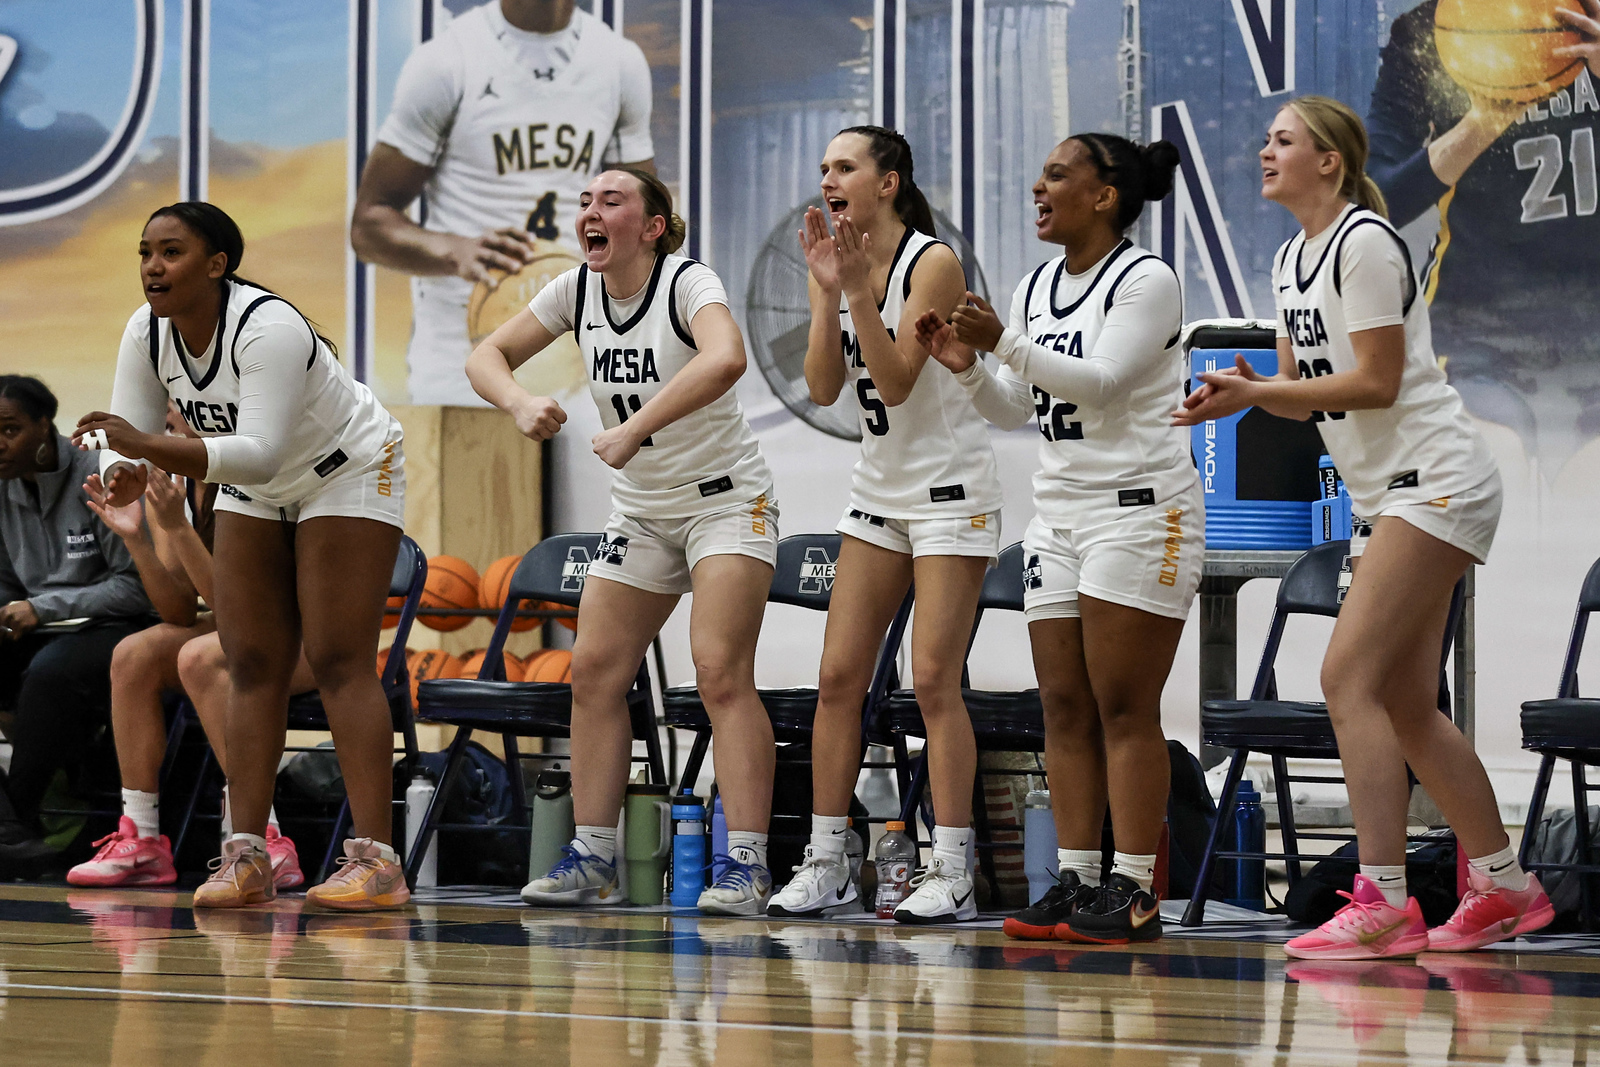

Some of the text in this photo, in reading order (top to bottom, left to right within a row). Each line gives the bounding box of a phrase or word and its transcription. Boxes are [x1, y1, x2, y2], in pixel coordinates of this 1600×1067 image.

[492, 123, 595, 175] MESA
[1513, 127, 1598, 223] 21
[526, 190, 560, 241] 4
[1283, 307, 1329, 347] MESA
[592, 346, 661, 384] MESA
[856, 378, 890, 437] 5
[1031, 384, 1084, 442] 22
[811, 564, 838, 577] MES
